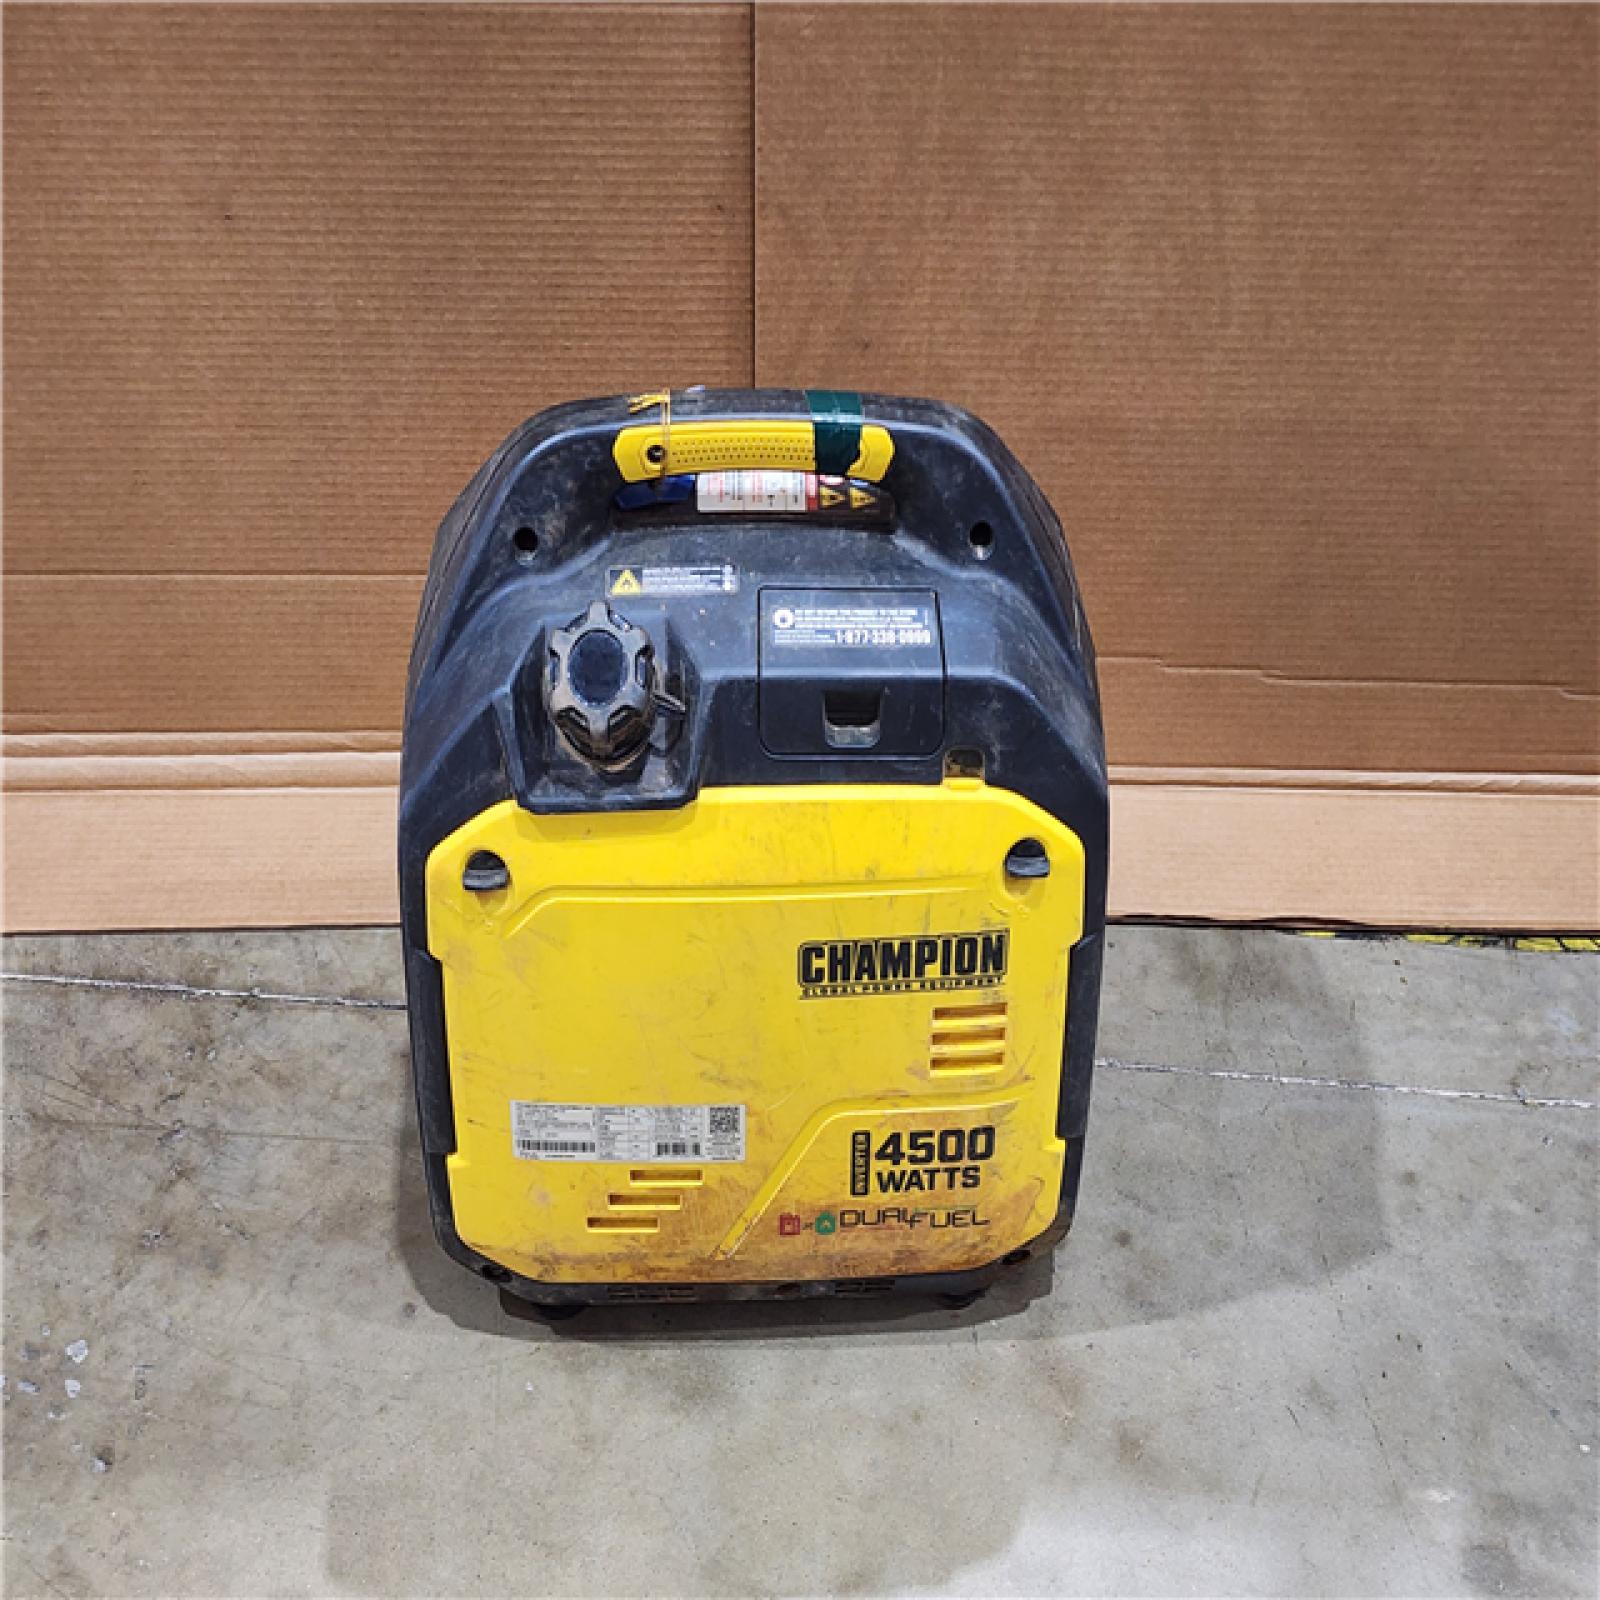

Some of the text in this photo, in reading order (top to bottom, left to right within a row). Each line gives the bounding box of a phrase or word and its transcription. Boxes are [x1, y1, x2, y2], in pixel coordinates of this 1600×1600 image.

[801, 934, 1005, 984] CHAMPION
[874, 1125, 996, 1166] 4500
[875, 1165, 981, 1194] WATTS
